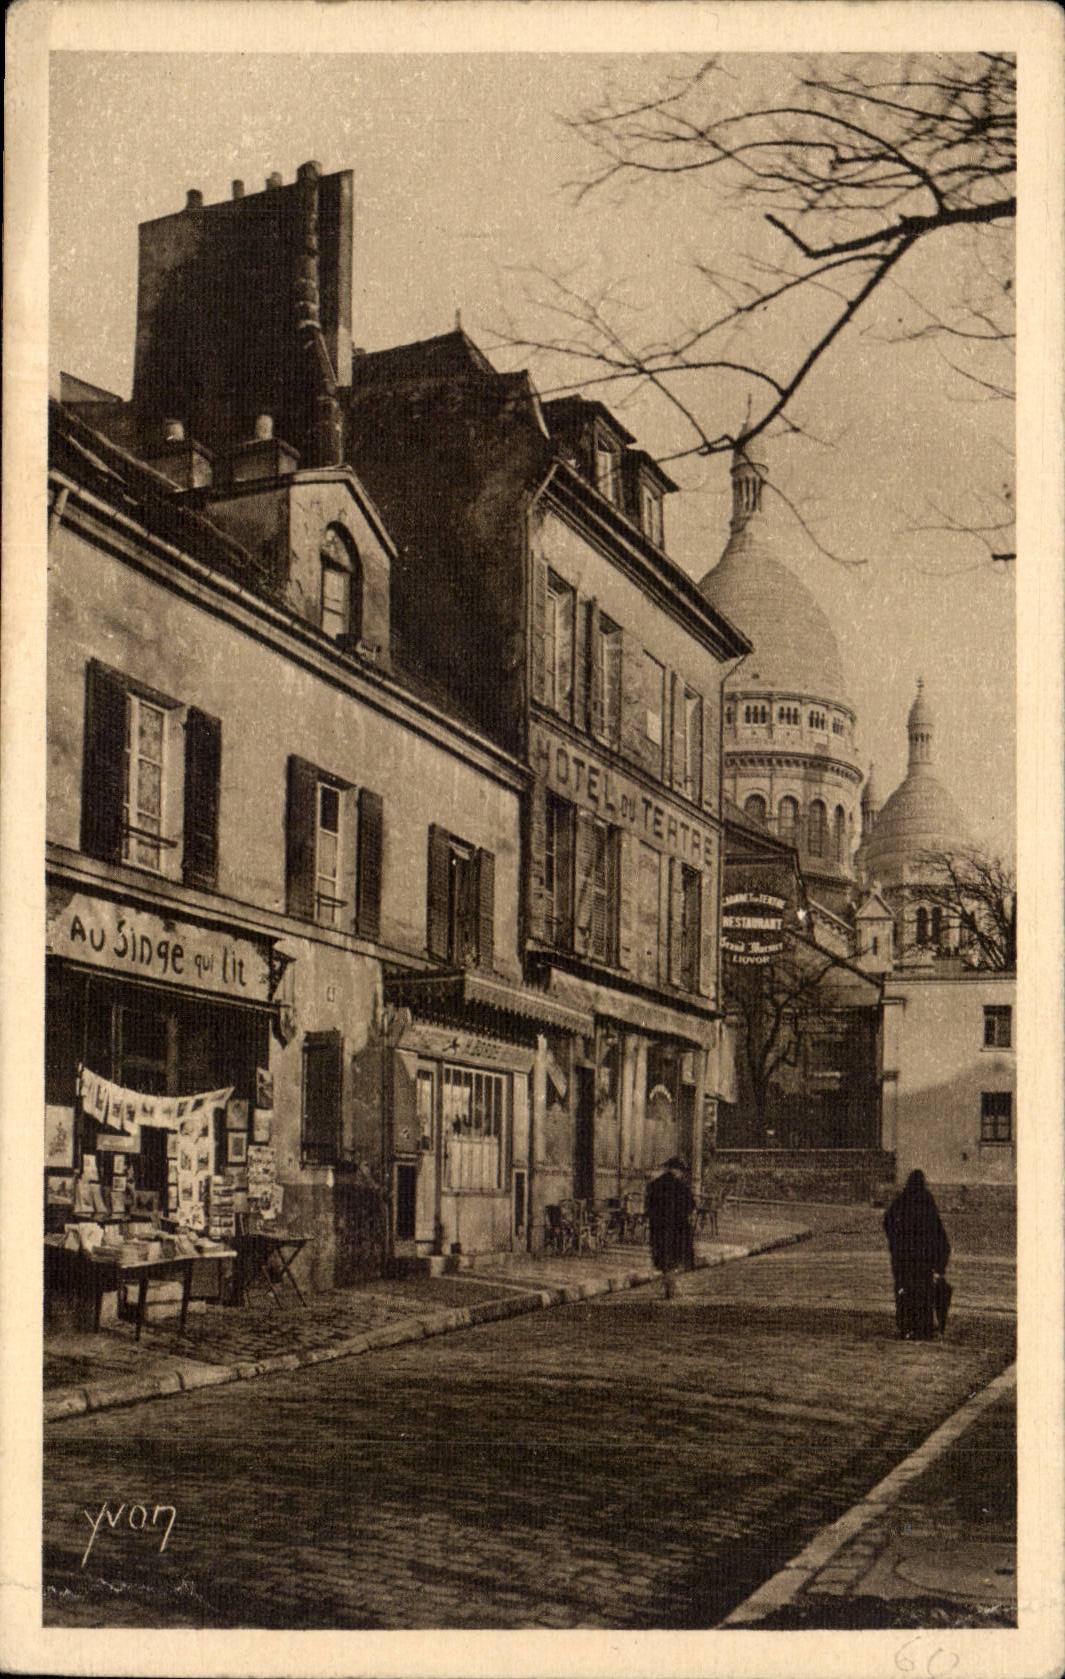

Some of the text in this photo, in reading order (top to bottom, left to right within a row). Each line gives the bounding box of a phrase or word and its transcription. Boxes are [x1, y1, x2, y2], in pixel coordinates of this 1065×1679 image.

[642, 796, 713, 868] TERTRE
[112, 919, 185, 975] Singe
[194, 952, 216, 979] qui
[222, 947, 247, 987] lit
[722, 916, 783, 930] RESTAURANT
